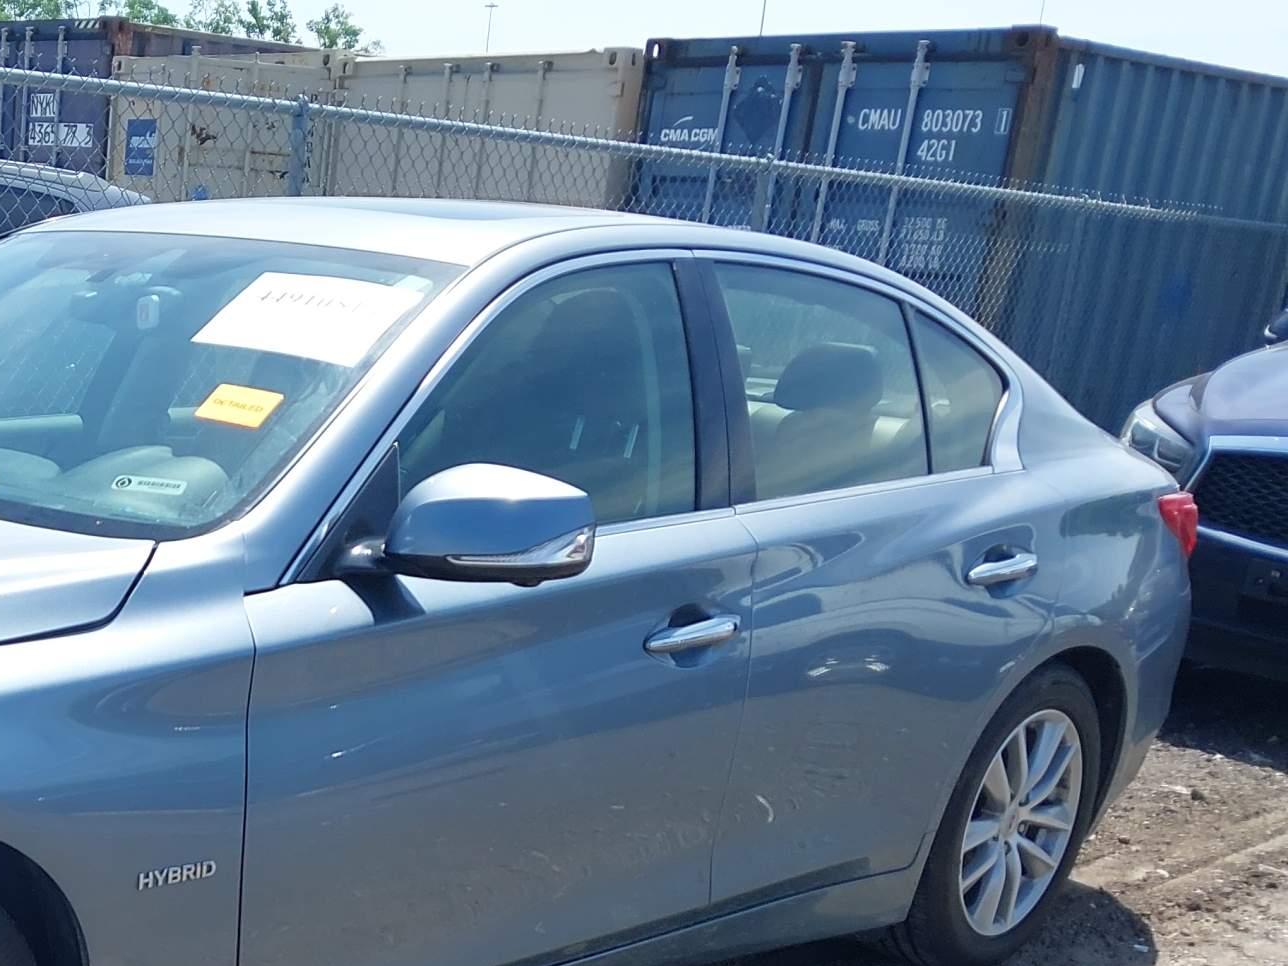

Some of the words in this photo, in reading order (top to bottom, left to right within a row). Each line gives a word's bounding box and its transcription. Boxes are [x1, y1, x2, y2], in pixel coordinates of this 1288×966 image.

[858, 108, 902, 131] CMAU
[921, 109, 983, 133] 803073
[660, 128, 689, 142] CMA
[917, 139, 957, 161] 42G1
[137, 860, 217, 891] HYBRID
